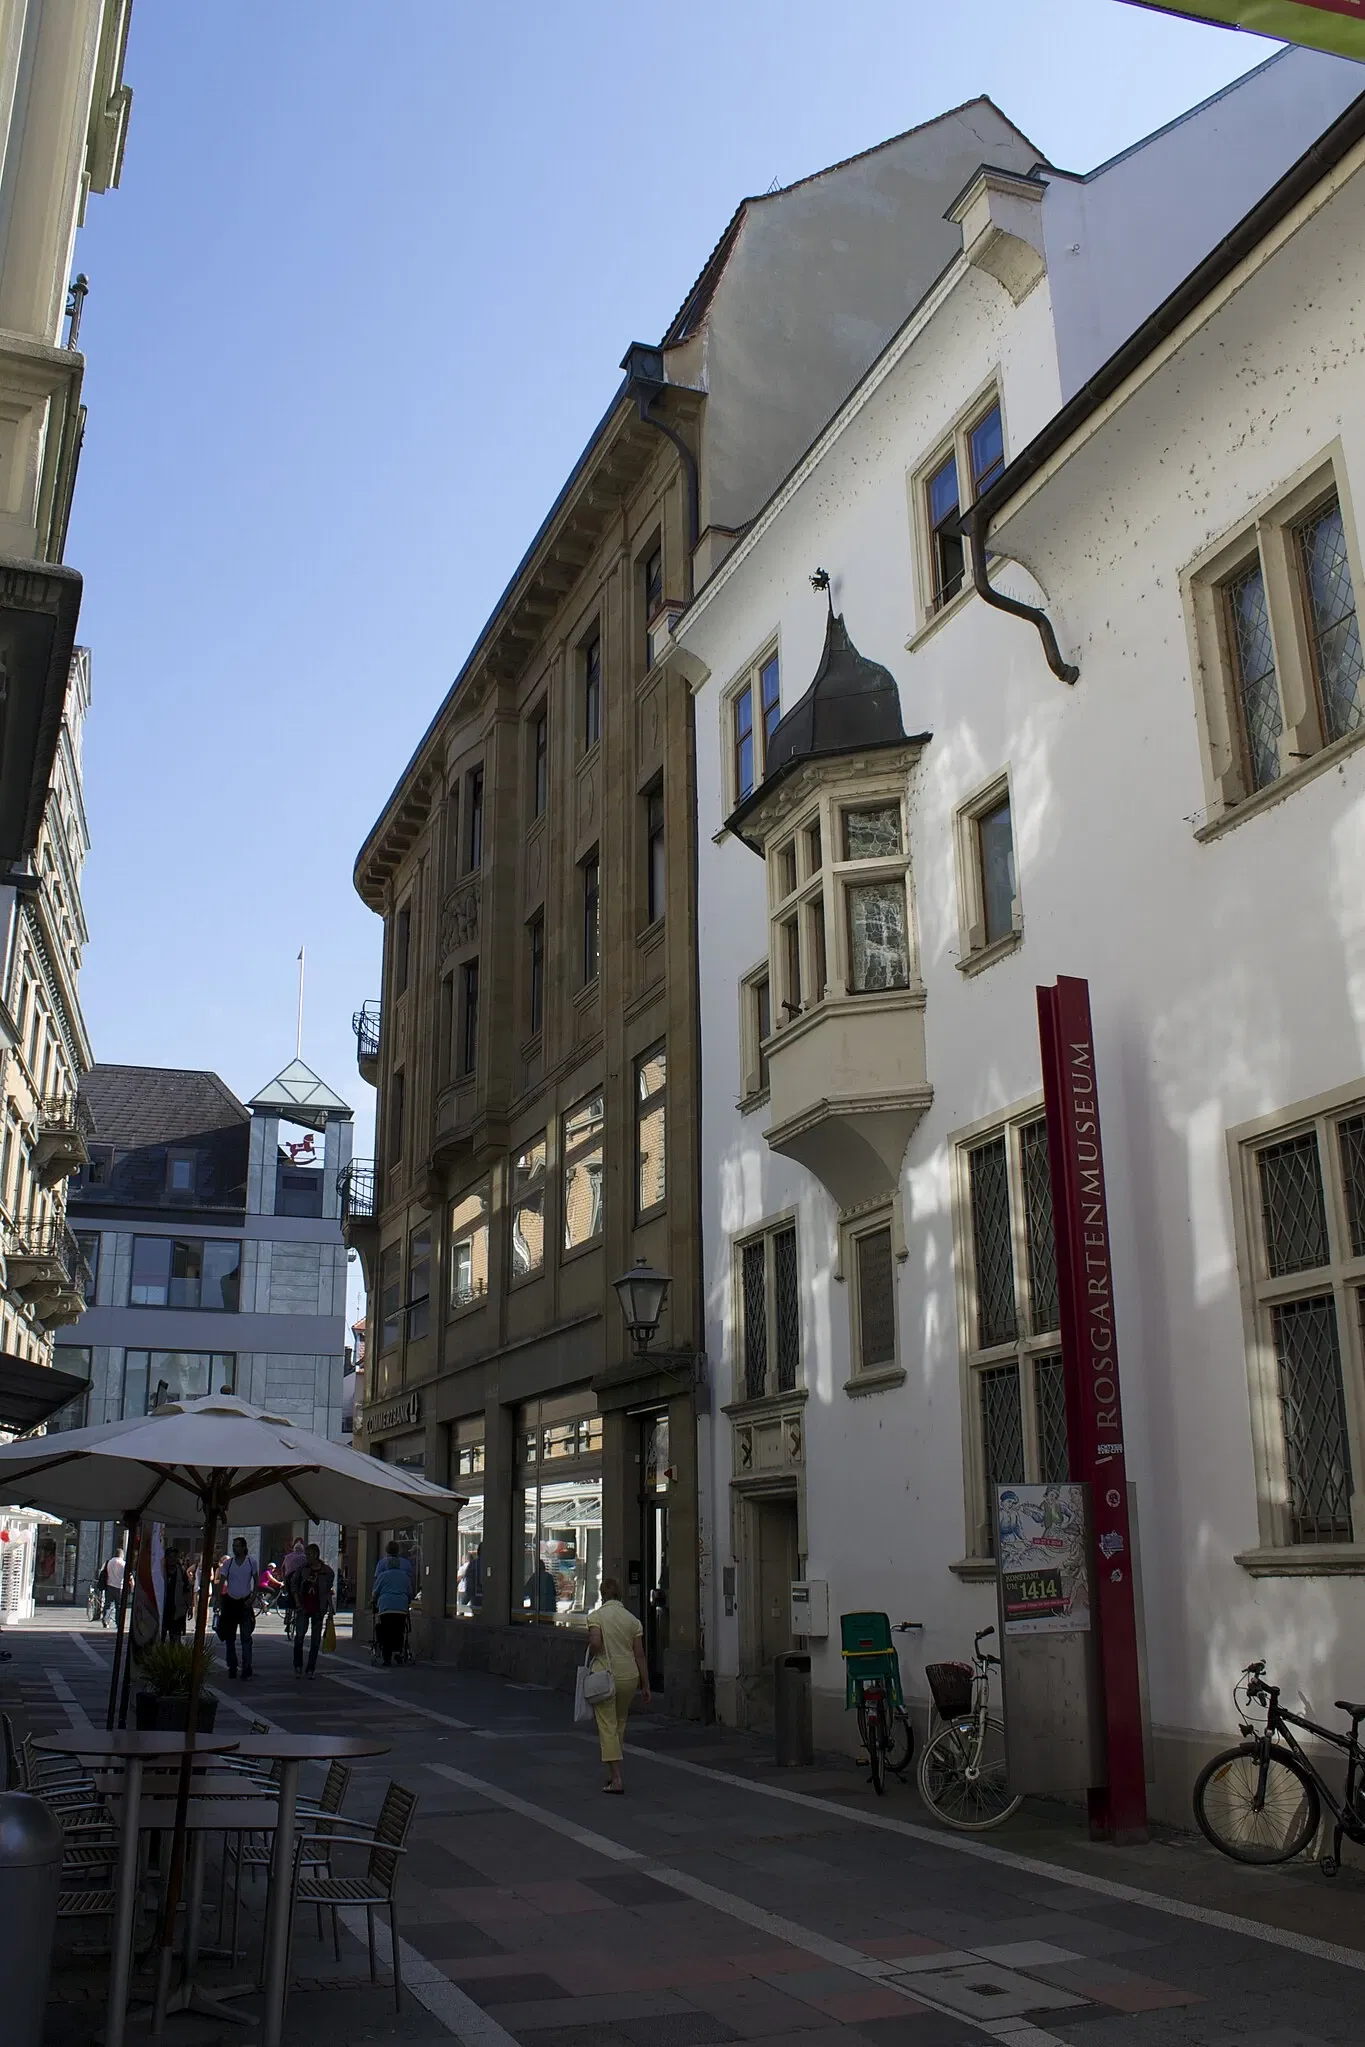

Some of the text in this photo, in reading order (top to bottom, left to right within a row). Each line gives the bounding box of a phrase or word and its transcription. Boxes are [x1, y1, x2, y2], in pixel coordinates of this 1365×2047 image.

[1069, 1040, 1118, 1431] ROSGARTENMUSEUM
[366, 1402, 409, 1434] COMMERZBANK
[1005, 1572, 1040, 1583] KONSTANZ
[1006, 1579, 1058, 1601] UM 1414
